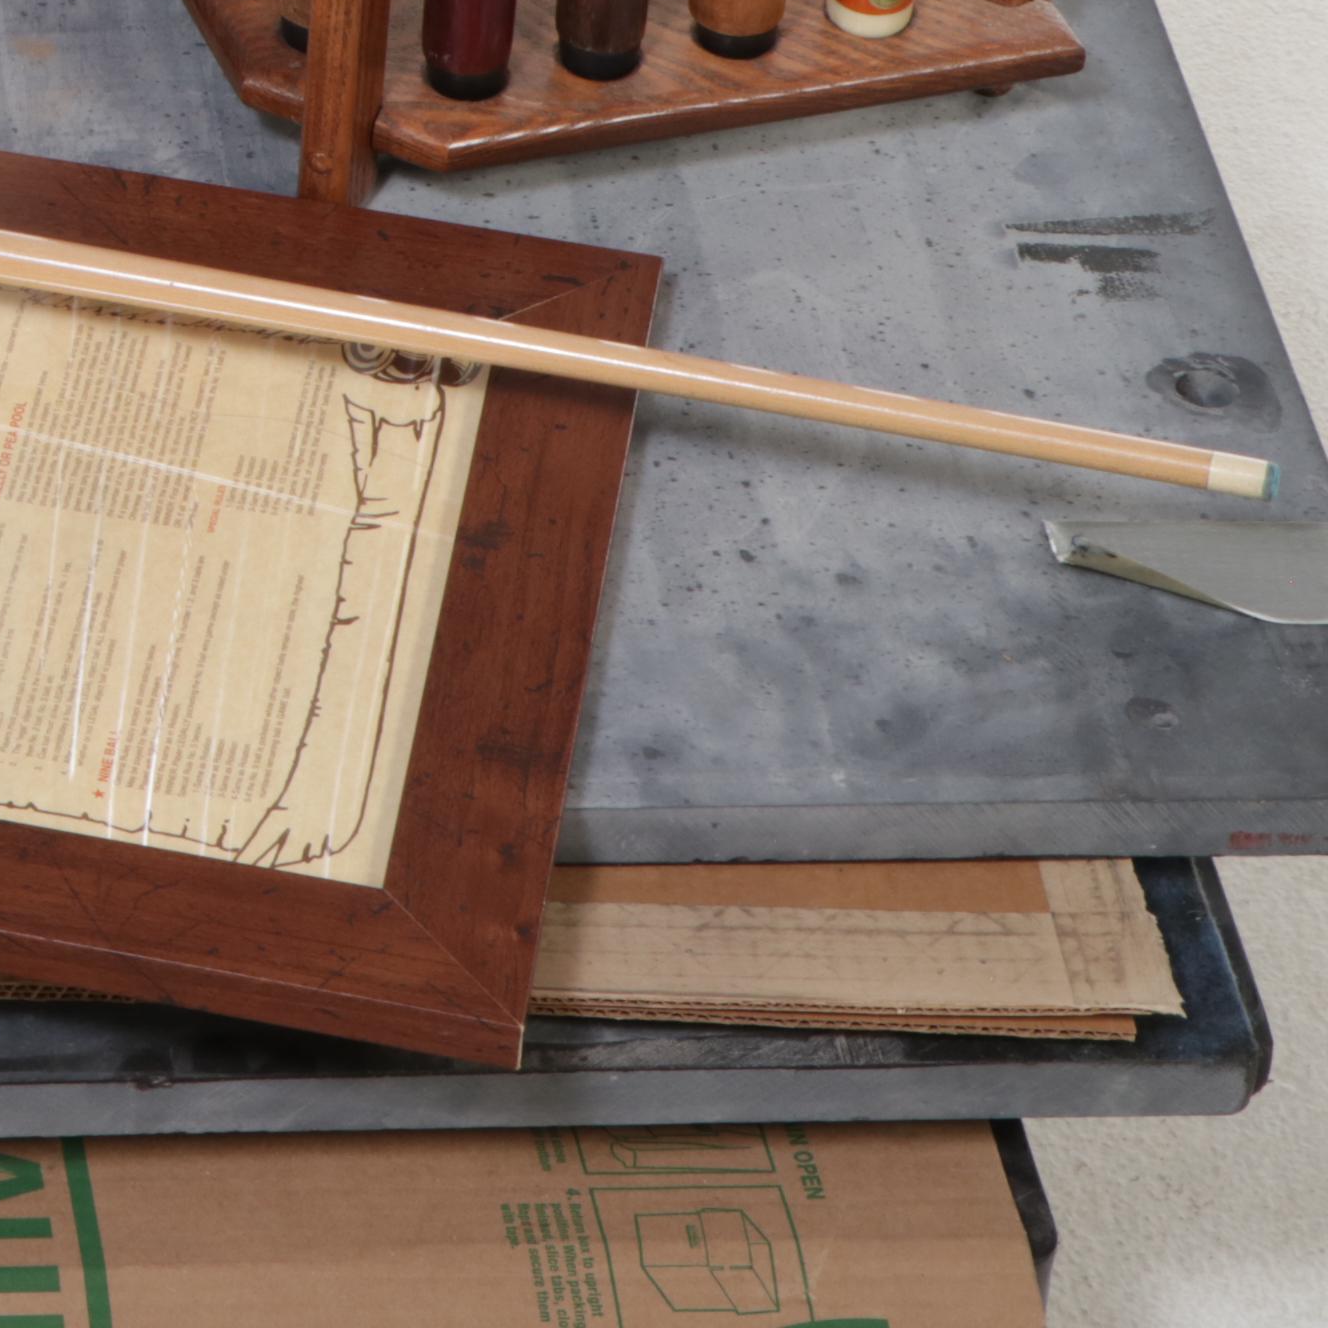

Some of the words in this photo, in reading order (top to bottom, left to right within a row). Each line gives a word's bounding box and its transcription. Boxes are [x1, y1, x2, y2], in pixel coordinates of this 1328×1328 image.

[10, 399, 29, 429] POOL
[4, 430, 19, 451] PEA
[0, 450, 13, 468] OR
[98, 757, 114, 784] NINE
[794, 1150, 827, 1201] OPEN
[546, 1244, 560, 1272] slice
[563, 1245, 577, 1277] When
[583, 1257, 593, 1269] to
[529, 1248, 544, 1288] secure
[537, 1291, 551, 1323] them
[584, 1273, 604, 1317] upright
[567, 1279, 587, 1328] packing
